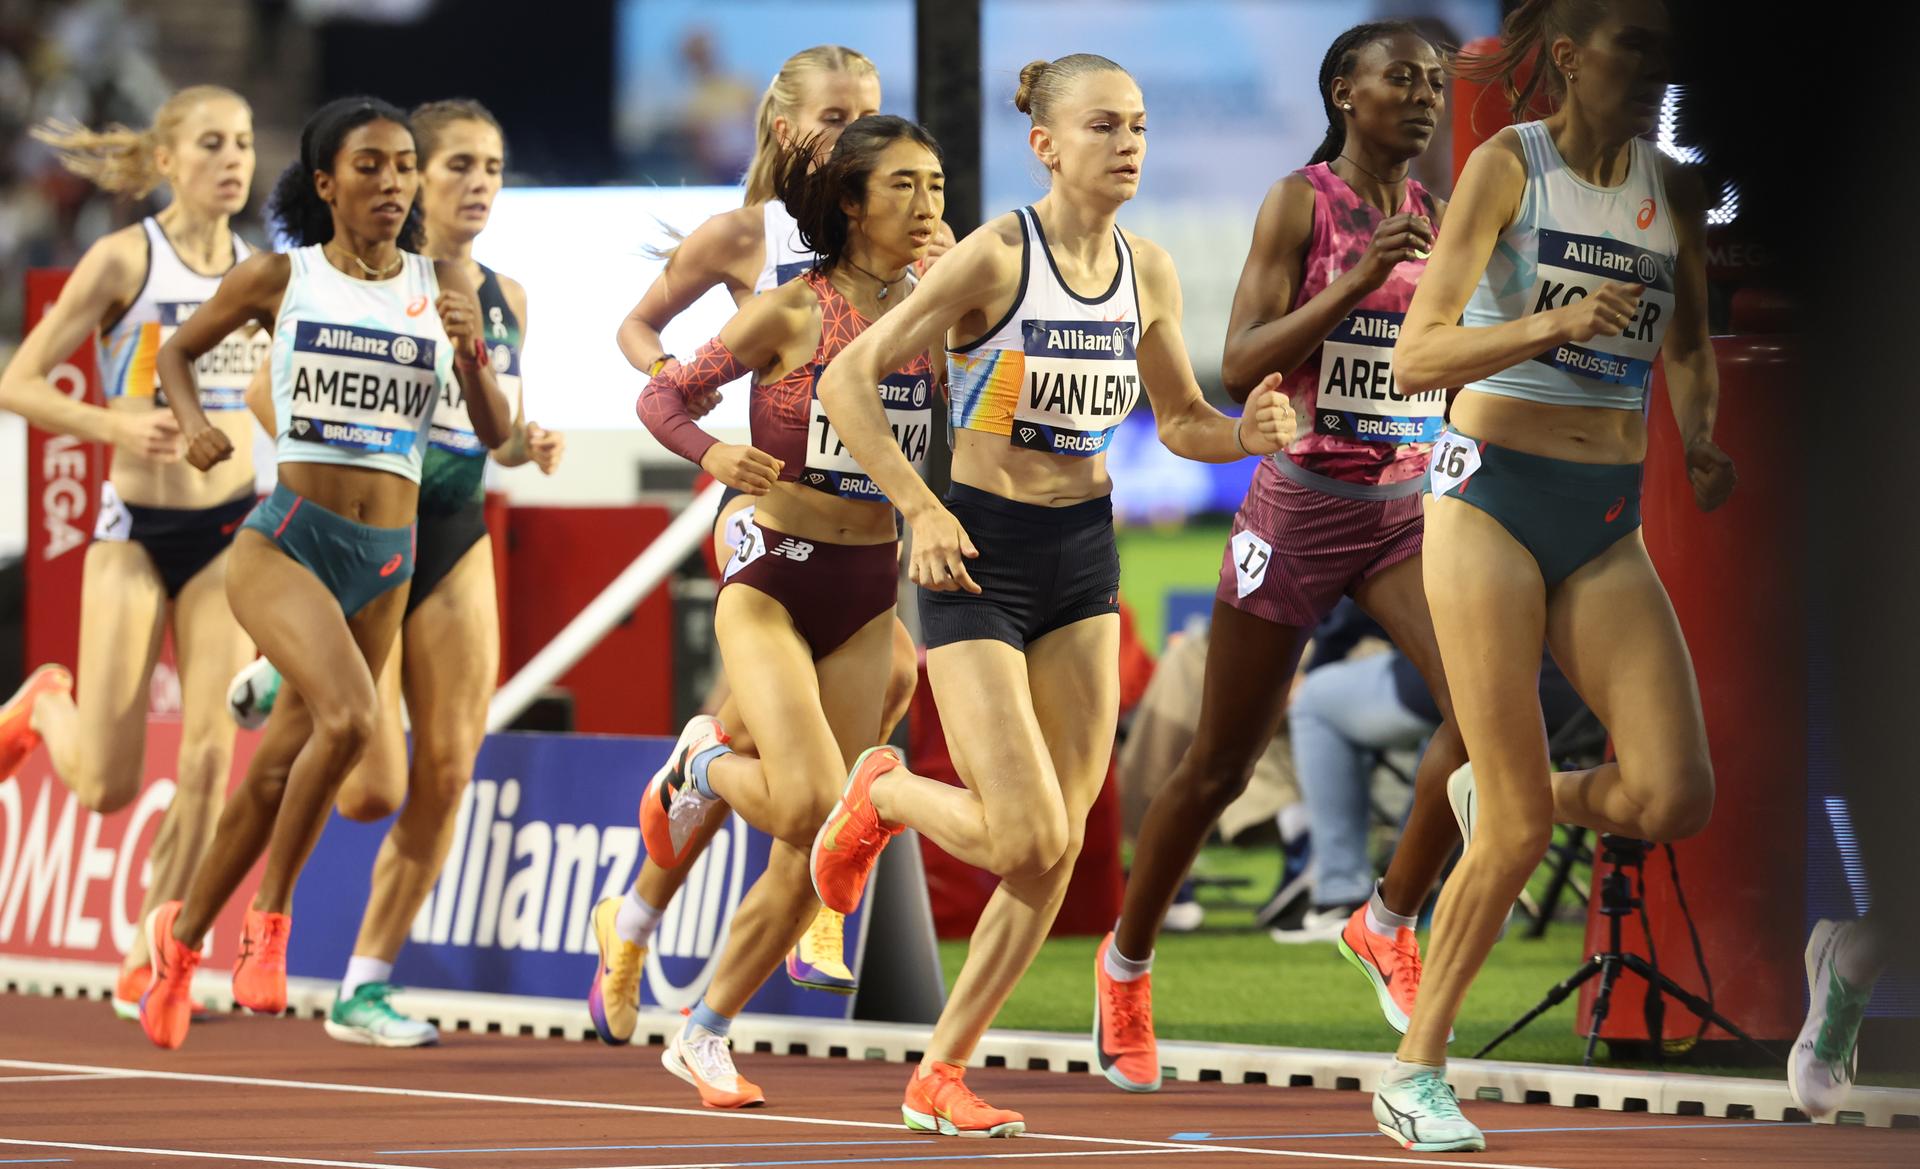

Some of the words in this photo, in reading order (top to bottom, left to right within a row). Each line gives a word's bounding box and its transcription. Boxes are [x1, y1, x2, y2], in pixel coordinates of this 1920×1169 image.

[1563, 241, 1634, 273] Allianz
[315, 327, 389, 356] Allianz
[1047, 329, 1113, 351] Allianz
[1350, 316, 1402, 339] Allia
[1555, 347, 1628, 377] BRUSSELS
[292, 366, 432, 419] AMEBAW
[1030, 371, 1088, 415] VAN
[1090, 374, 1137, 416] LENT
[323, 424, 393, 446] BRUSSELS
[1357, 419, 1424, 436] BRUSSELS
[1434, 441, 1468, 478] 16
[1239, 542, 1268, 579] 17
